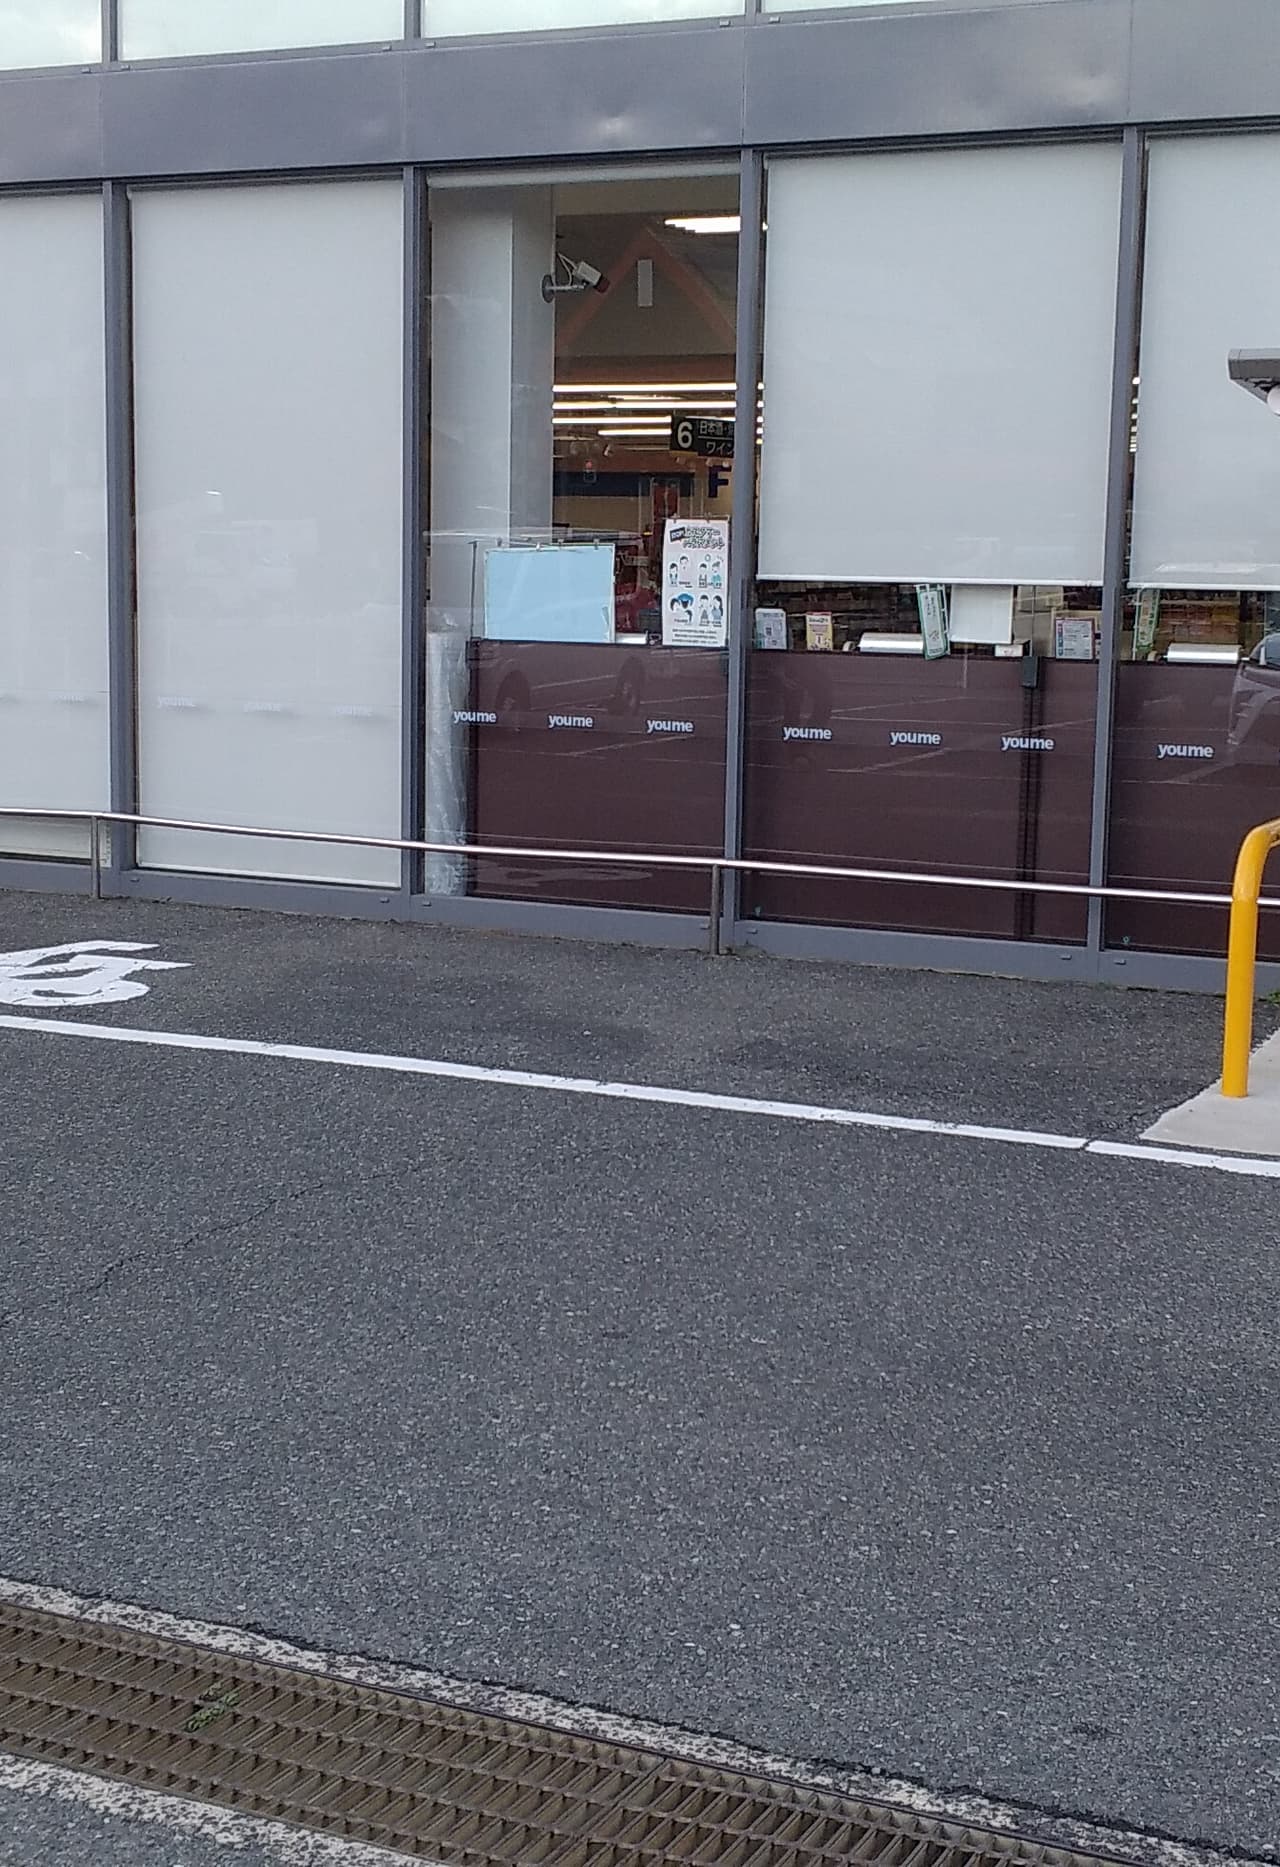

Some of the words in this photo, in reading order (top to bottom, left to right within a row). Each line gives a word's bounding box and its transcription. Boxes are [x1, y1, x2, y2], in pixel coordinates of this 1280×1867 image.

[677, 421, 693, 449] 6
[453, 710, 497, 724] youme
[549, 714, 593, 729] youme
[647, 719, 693, 734] youme
[784, 726, 832, 741] youme
[891, 731, 941, 746] youme
[1002, 736, 1054, 751] youme
[1158, 744, 1213, 759] youme
